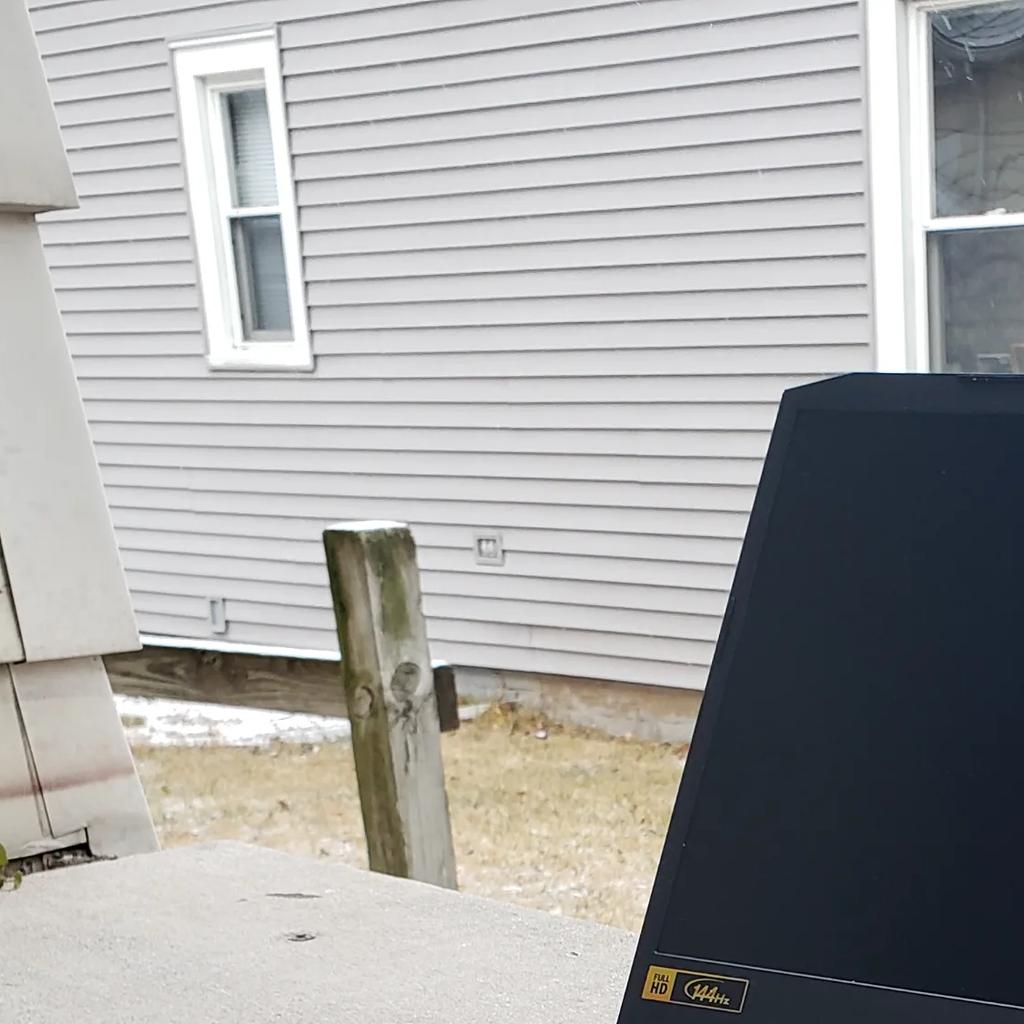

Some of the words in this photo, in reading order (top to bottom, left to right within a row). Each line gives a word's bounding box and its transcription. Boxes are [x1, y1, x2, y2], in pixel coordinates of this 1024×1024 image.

[654, 973, 670, 982] FULL
[650, 982, 668, 995] HD
[692, 984, 730, 1005] 144Hz
